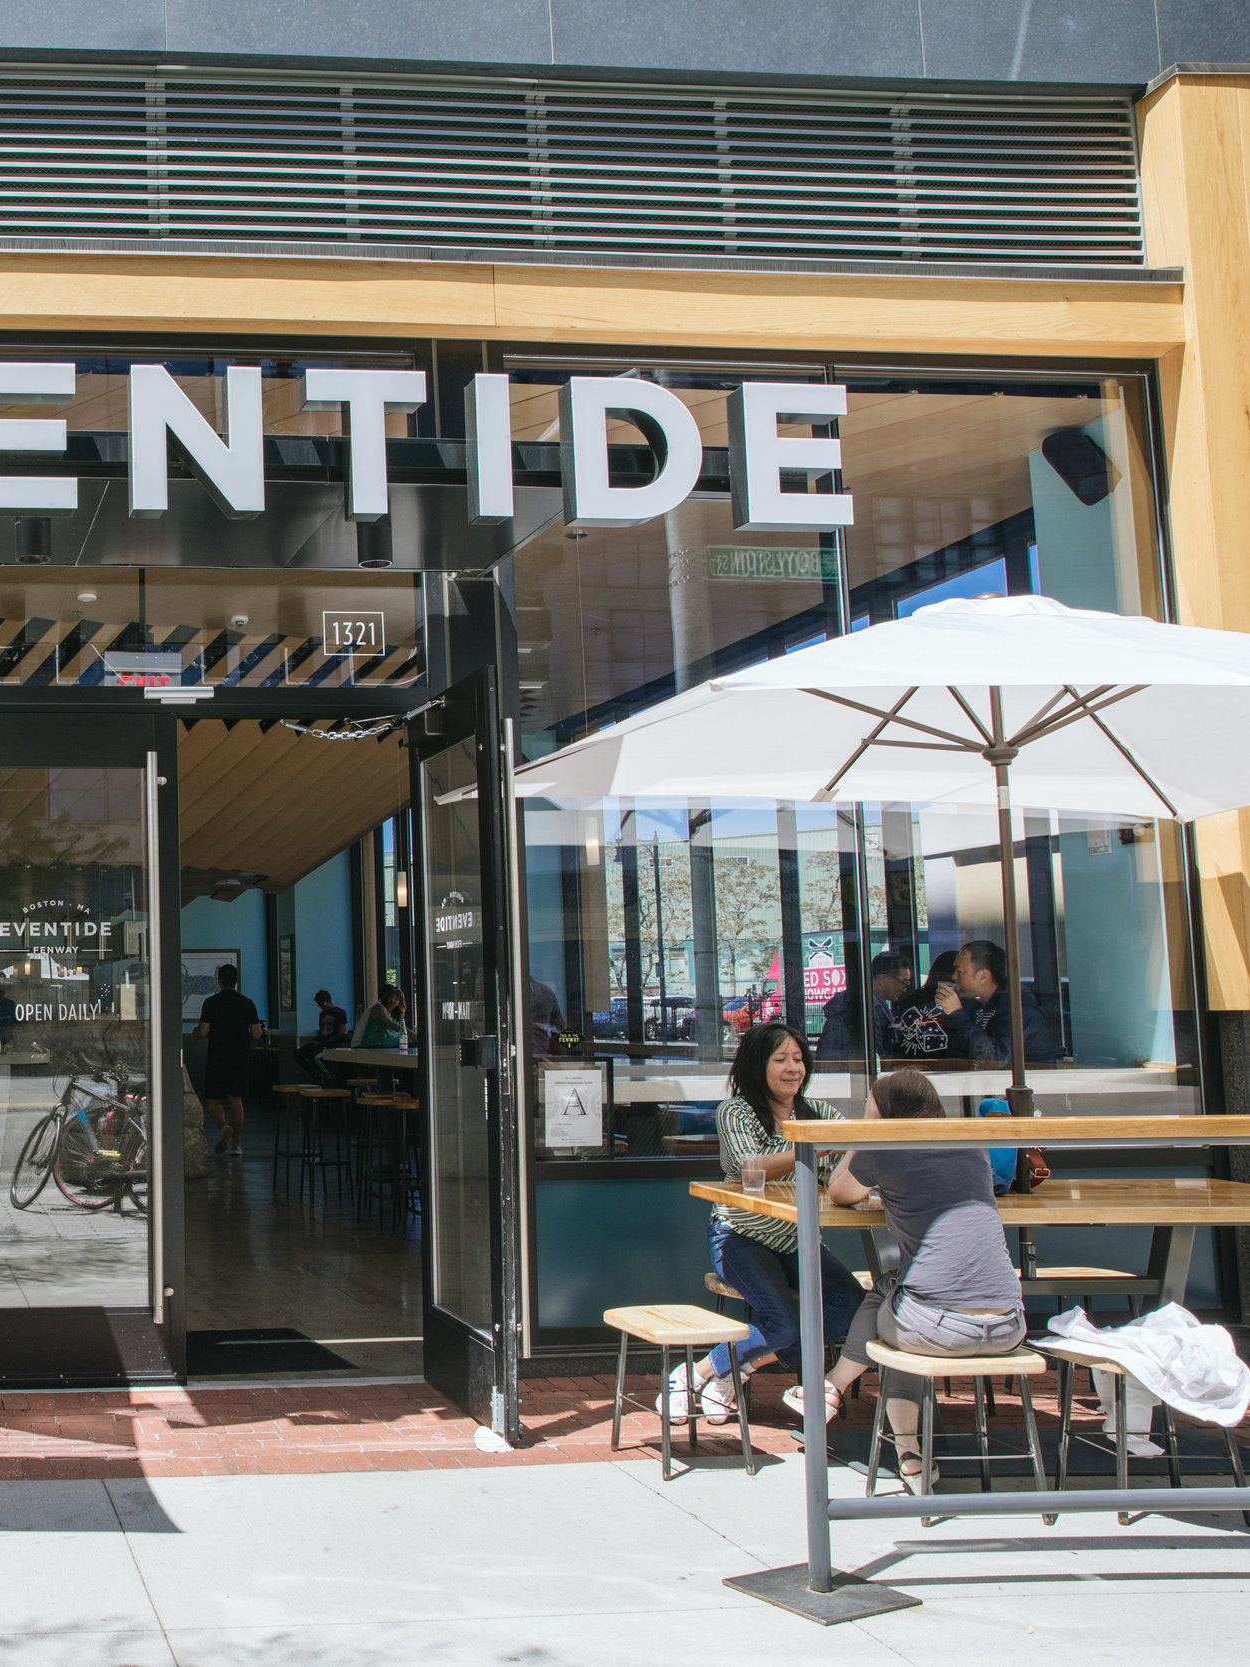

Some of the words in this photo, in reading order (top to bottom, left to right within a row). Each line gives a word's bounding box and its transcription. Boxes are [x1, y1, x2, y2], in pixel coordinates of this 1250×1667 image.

[332, 621, 376, 647] 1321
[22, 899, 64, 914] BOSTON
[76, 903, 91, 915] MA
[0, 921, 112, 937] EVENTIDE
[33, 946, 79, 954] FENWAY
[15, 1003, 53, 1022] OPEN
[59, 1003, 98, 1021] DAILY
[561, 1088, 588, 1116] A
